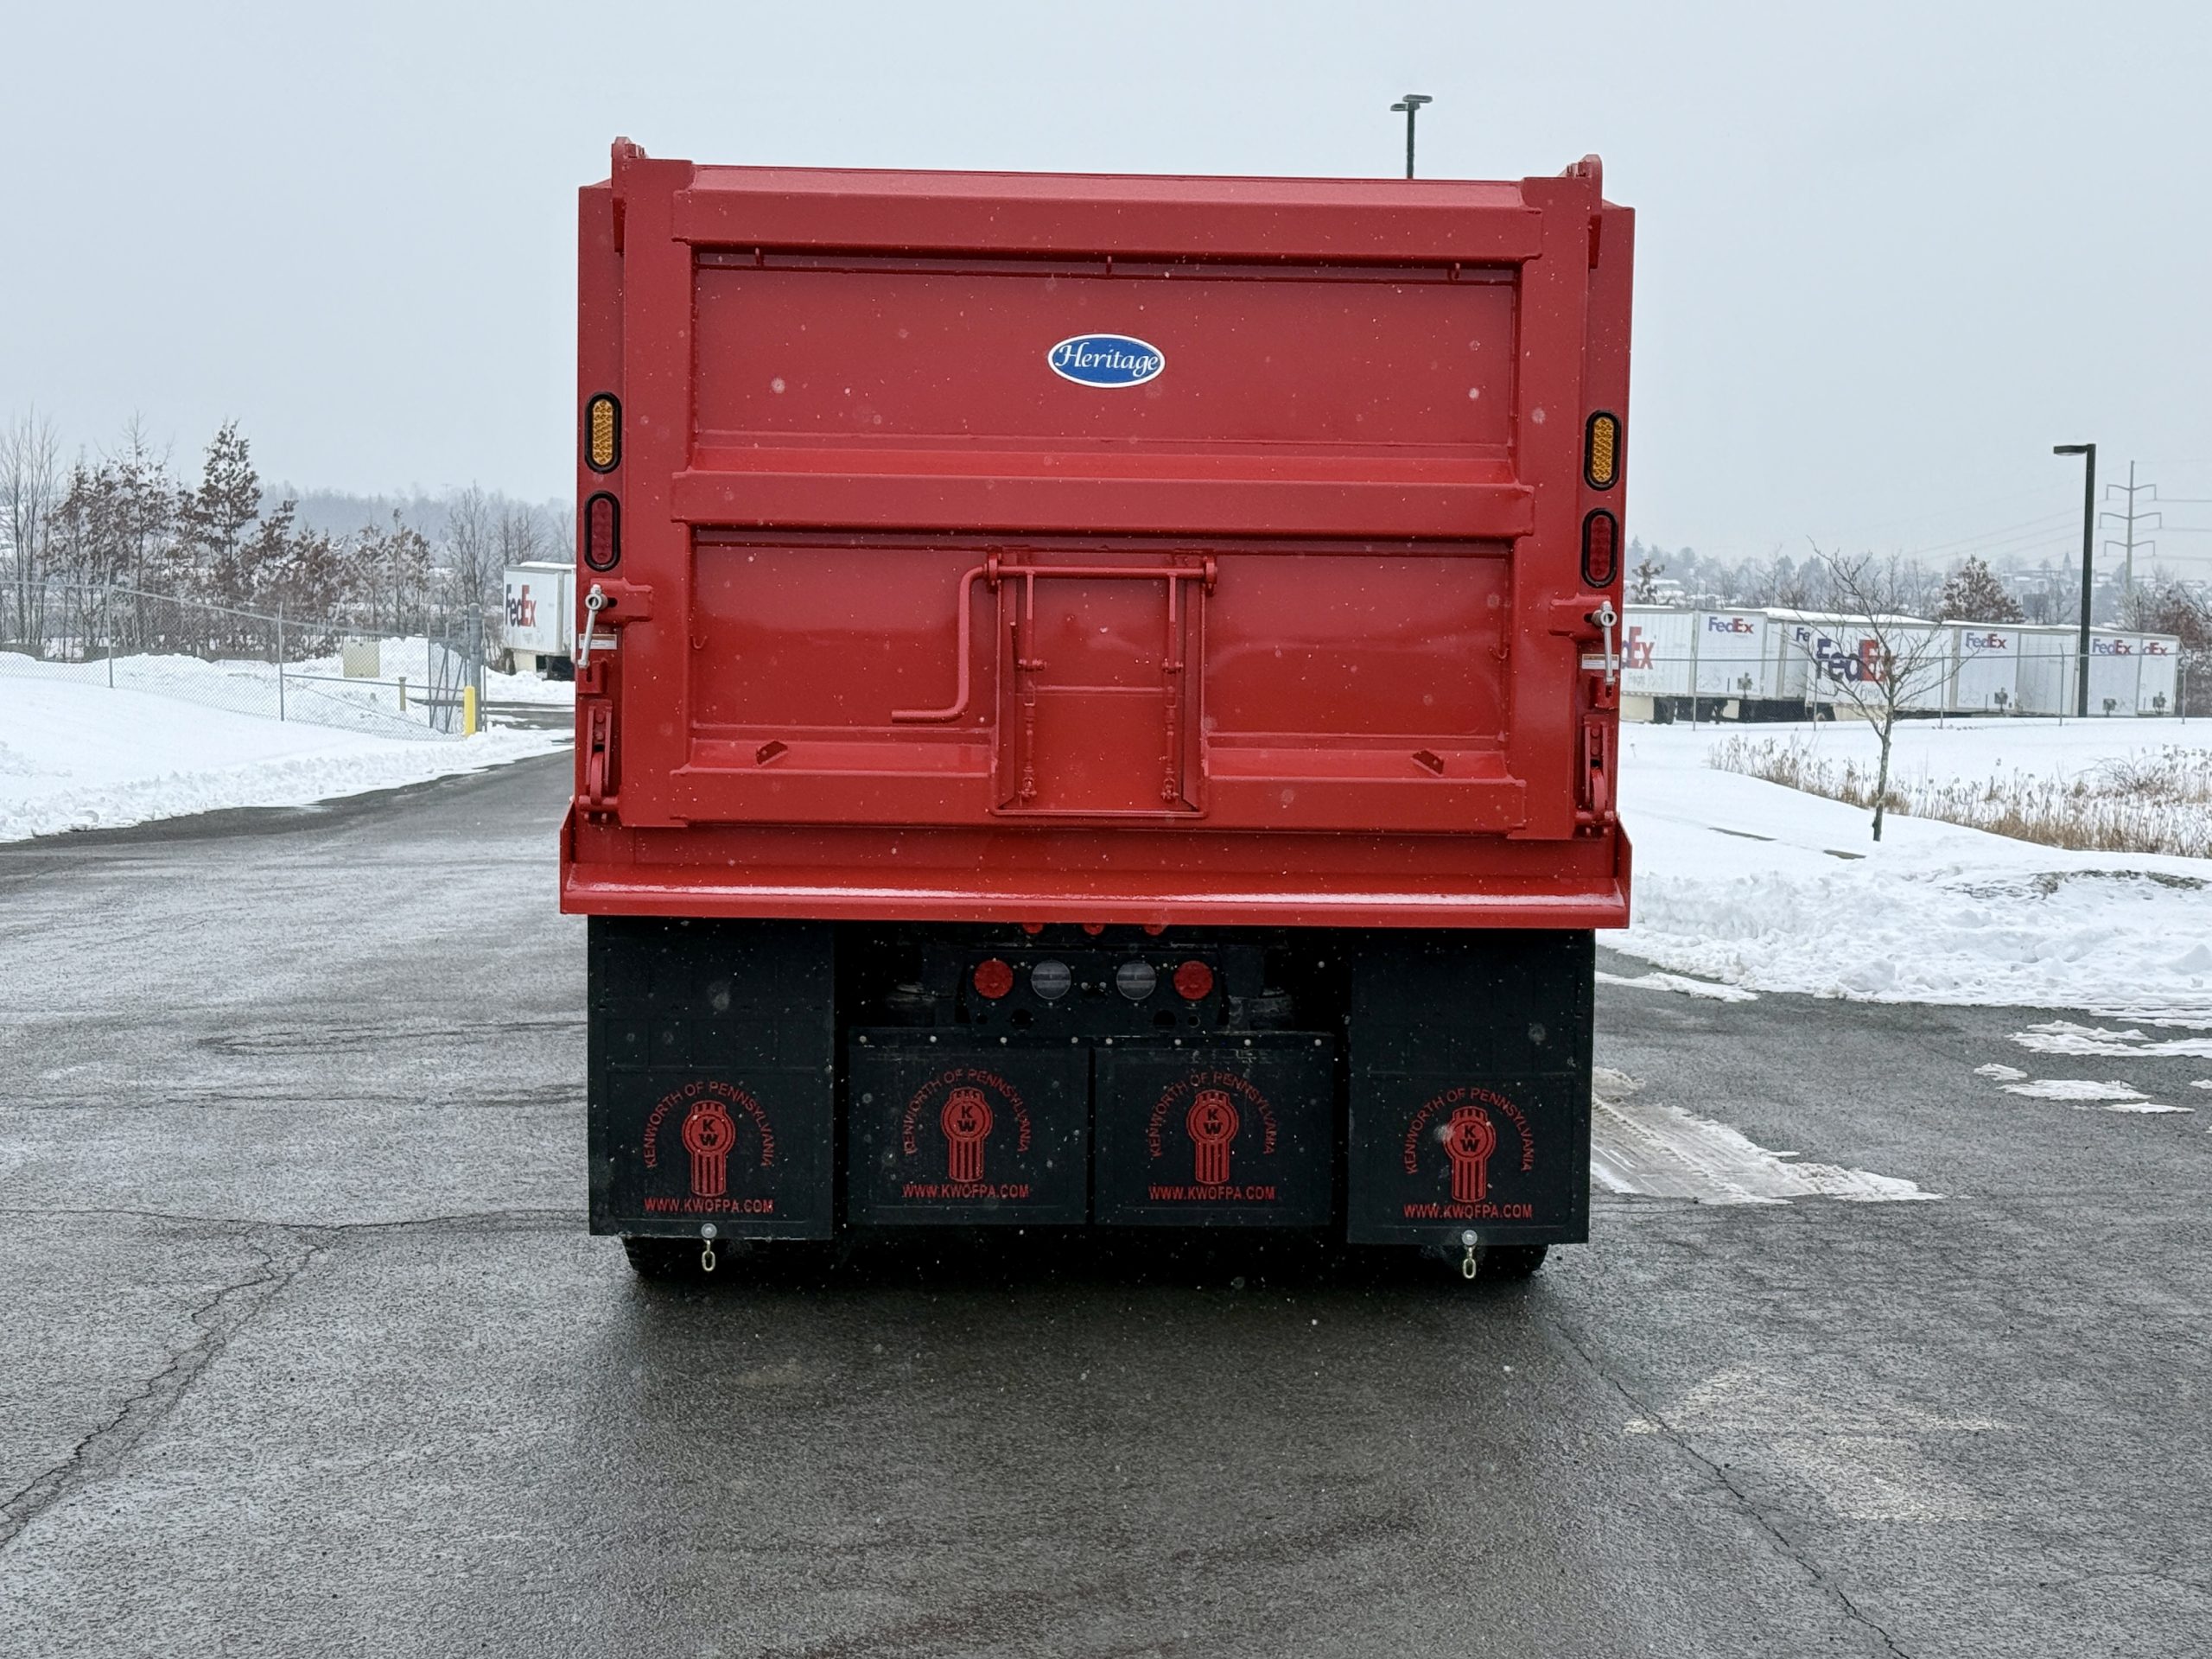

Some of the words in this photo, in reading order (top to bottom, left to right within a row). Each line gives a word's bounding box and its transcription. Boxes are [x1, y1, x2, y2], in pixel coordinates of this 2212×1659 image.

[1054, 342, 1159, 377] Heritage
[505, 584, 537, 627] FedEx
[1708, 616, 1754, 633] FedEx
[1622, 626, 1655, 670] dEx
[1966, 632, 2006, 649] FedEx
[2093, 639, 2133, 655] FedEx
[2143, 642, 2168, 656] dEx
[944, 1069, 963, 1084] OF
[1148, 1081, 1189, 1157] KENWORTH
[1190, 1072, 1208, 1086] OF
[643, 1090, 683, 1168] KENWORTH
[684, 1082, 704, 1096] OF
[709, 1081, 774, 1167] PENNSYLVANIA
[1404, 1096, 1445, 1174] KENWORTH
[1446, 1088, 1465, 1103] OF
[1471, 1087, 1534, 1172] PENNSYLVANIA
[903, 1184, 1029, 1198] WWW.KWOFPA.COM
[1148, 1185, 1275, 1200] WWW.KWOFPA.COM
[644, 1198, 774, 1213] WWW.KWOFPA.COM
[1404, 1204, 1533, 1218] WWW.KWOFPA.COM
